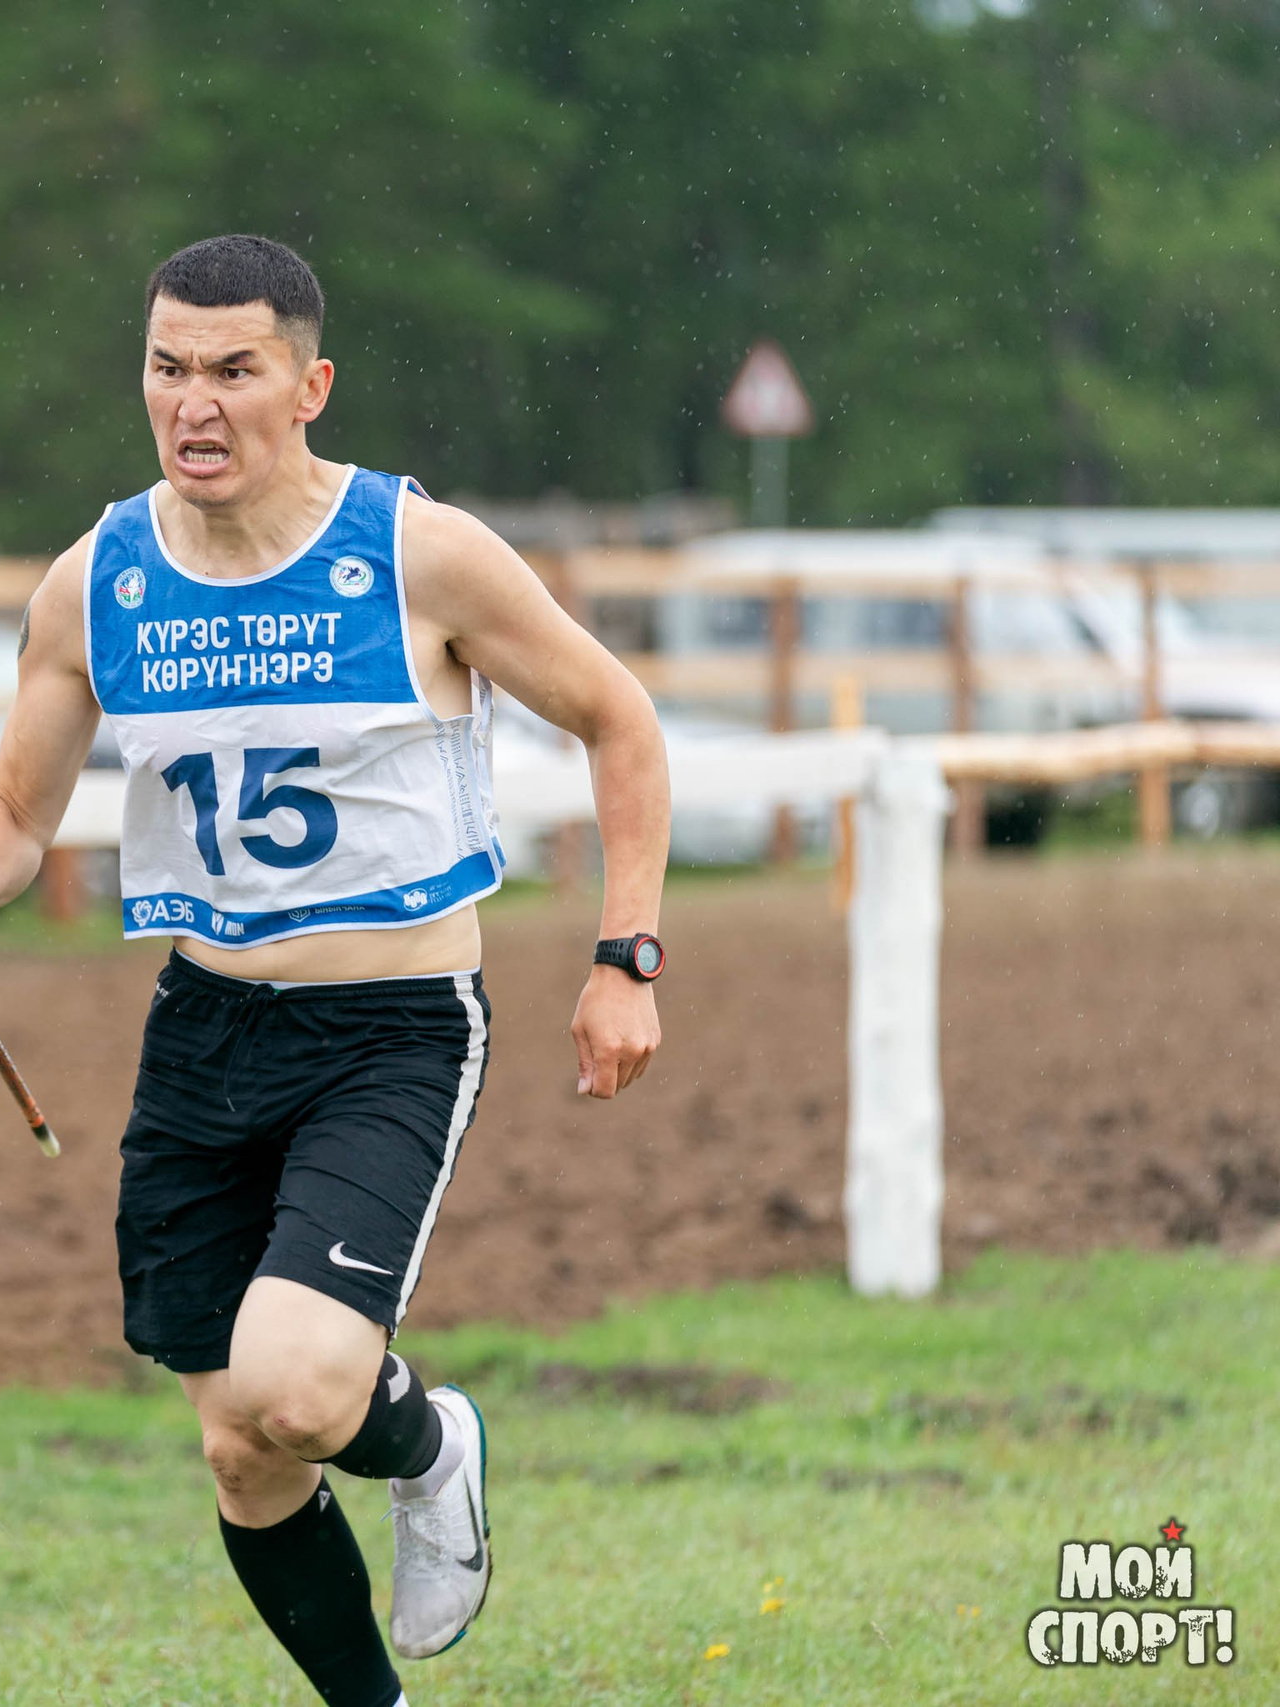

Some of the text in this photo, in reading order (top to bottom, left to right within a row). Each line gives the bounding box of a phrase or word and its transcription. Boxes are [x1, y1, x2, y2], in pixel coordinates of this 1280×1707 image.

[137, 612, 342, 654] КҮРЭС ТӨРҮТ
[160, 747, 339, 876] 15
[151, 899, 195, 923] АЭБ
